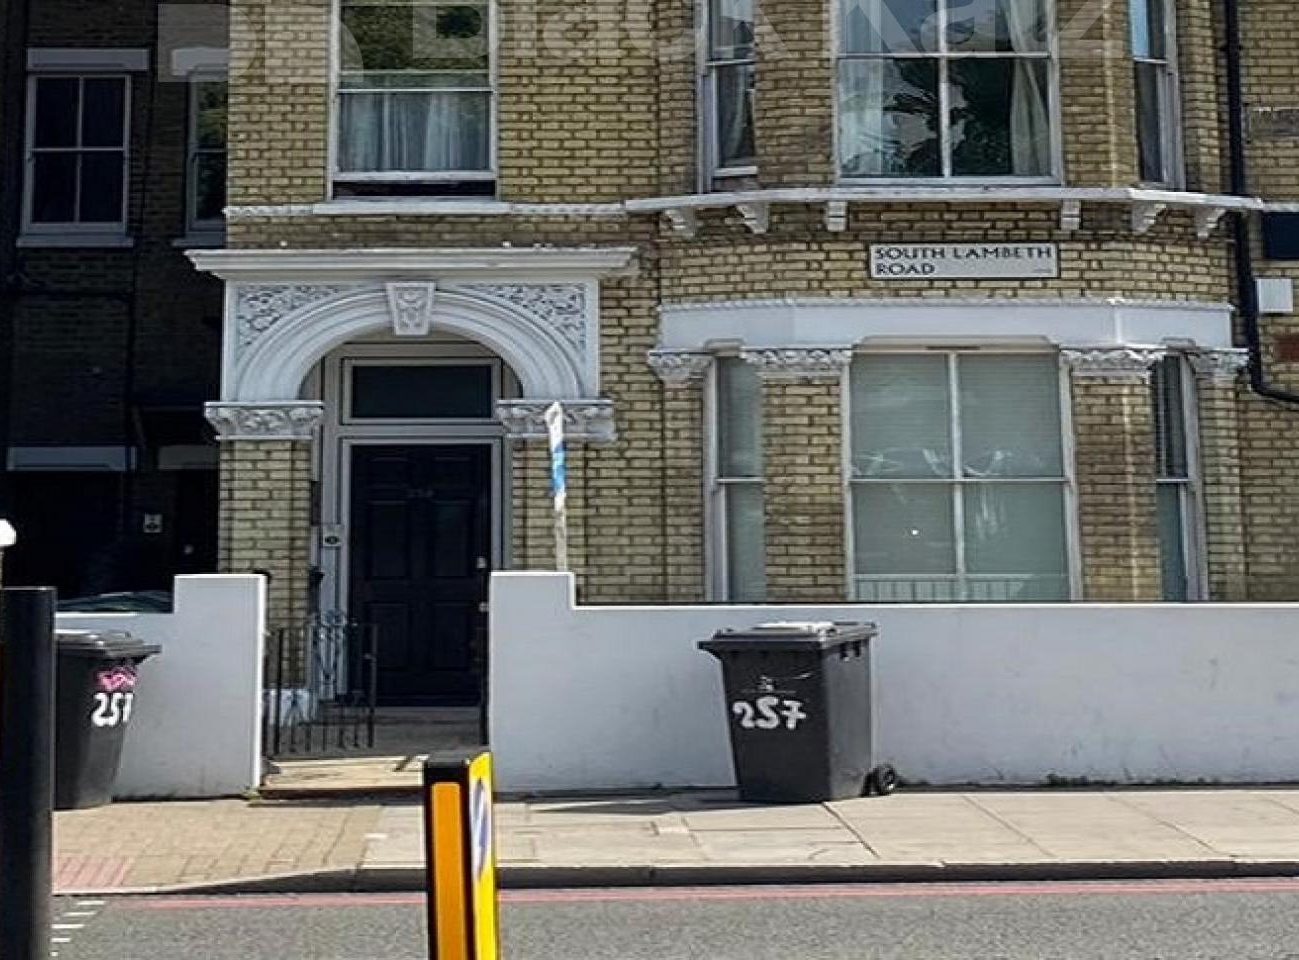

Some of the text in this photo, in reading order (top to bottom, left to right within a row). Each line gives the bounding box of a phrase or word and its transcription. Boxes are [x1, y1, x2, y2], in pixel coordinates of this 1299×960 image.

[875, 247, 1052, 259] SOUTH LAMBETH
[875, 262, 936, 275] ROAD
[732, 696, 807, 730] 257
